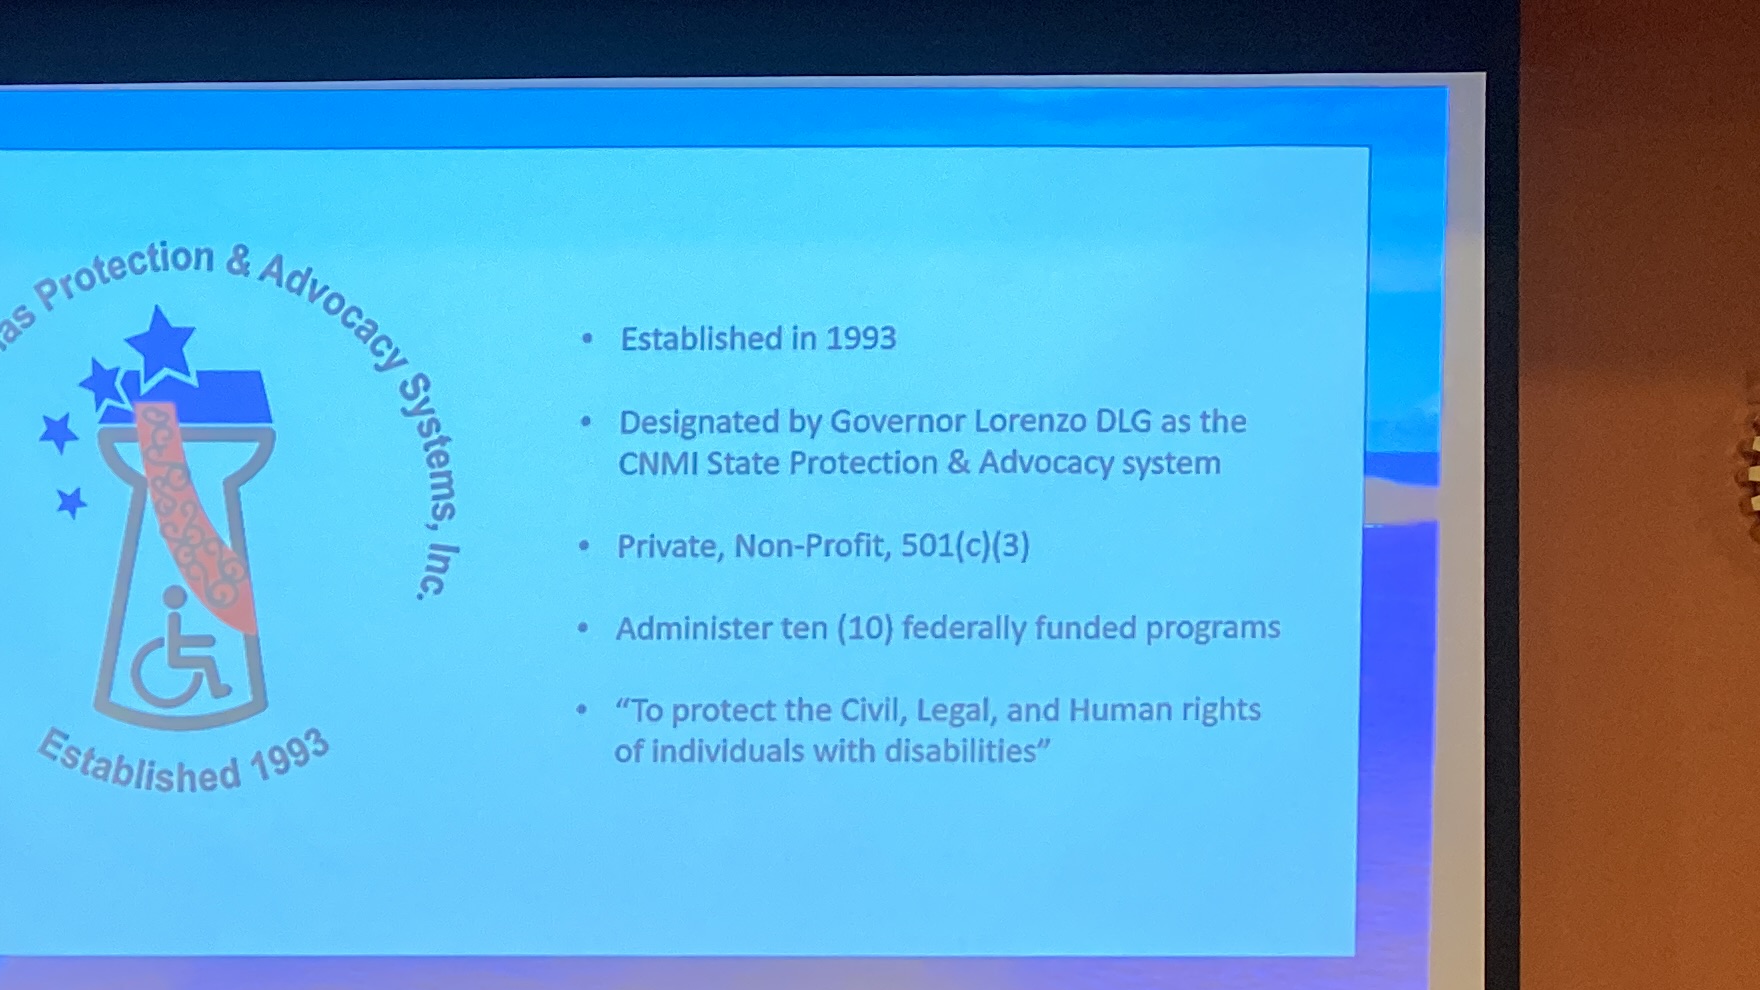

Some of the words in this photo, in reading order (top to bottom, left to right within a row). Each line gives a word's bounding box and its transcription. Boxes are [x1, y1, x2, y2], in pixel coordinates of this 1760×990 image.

[34, 240, 214, 313] Protection
[226, 243, 251, 277] &
[258, 252, 409, 372] Advocacy
[622, 324, 782, 351] Established
[792, 324, 817, 351] in
[826, 325, 897, 351] 1993
[620, 408, 779, 441] Designated
[789, 407, 823, 440] by
[830, 409, 967, 433] Governor
[975, 409, 1087, 433] Lorenzo
[1097, 408, 1152, 433] DLG
[1161, 414, 1191, 433] as
[1200, 408, 1247, 433] the
[398, 373, 458, 533] Systems,
[619, 451, 698, 476] CNMI
[707, 451, 780, 476] State
[790, 450, 938, 475] Protection
[947, 449, 971, 474] &
[979, 448, 1115, 481] Advocacy
[1122, 452, 1221, 481] system
[618, 533, 724, 563] Private,
[735, 532, 891, 562] Non-Profit,
[901, 530, 1030, 564] 501(c)(3)
[415, 543, 461, 602] Inc.
[616, 615, 774, 640] Administer
[780, 617, 828, 640] ten
[838, 613, 893, 646] (10)
[902, 614, 1027, 647] federally
[1035, 614, 1136, 640] funded
[1147, 620, 1281, 646] programs
[673, 699, 777, 729] protect
[784, 697, 832, 722] the
[841, 696, 907, 727] Civil,
[918, 696, 997, 728] Legal,
[1007, 697, 1060, 722] and
[1070, 698, 1172, 722] Human
[1183, 696, 1261, 727] rights
[37, 725, 241, 793] Established
[249, 726, 330, 783] 1993
[614, 738, 646, 763] of
[653, 737, 804, 763] individuals
[813, 737, 876, 763] with
